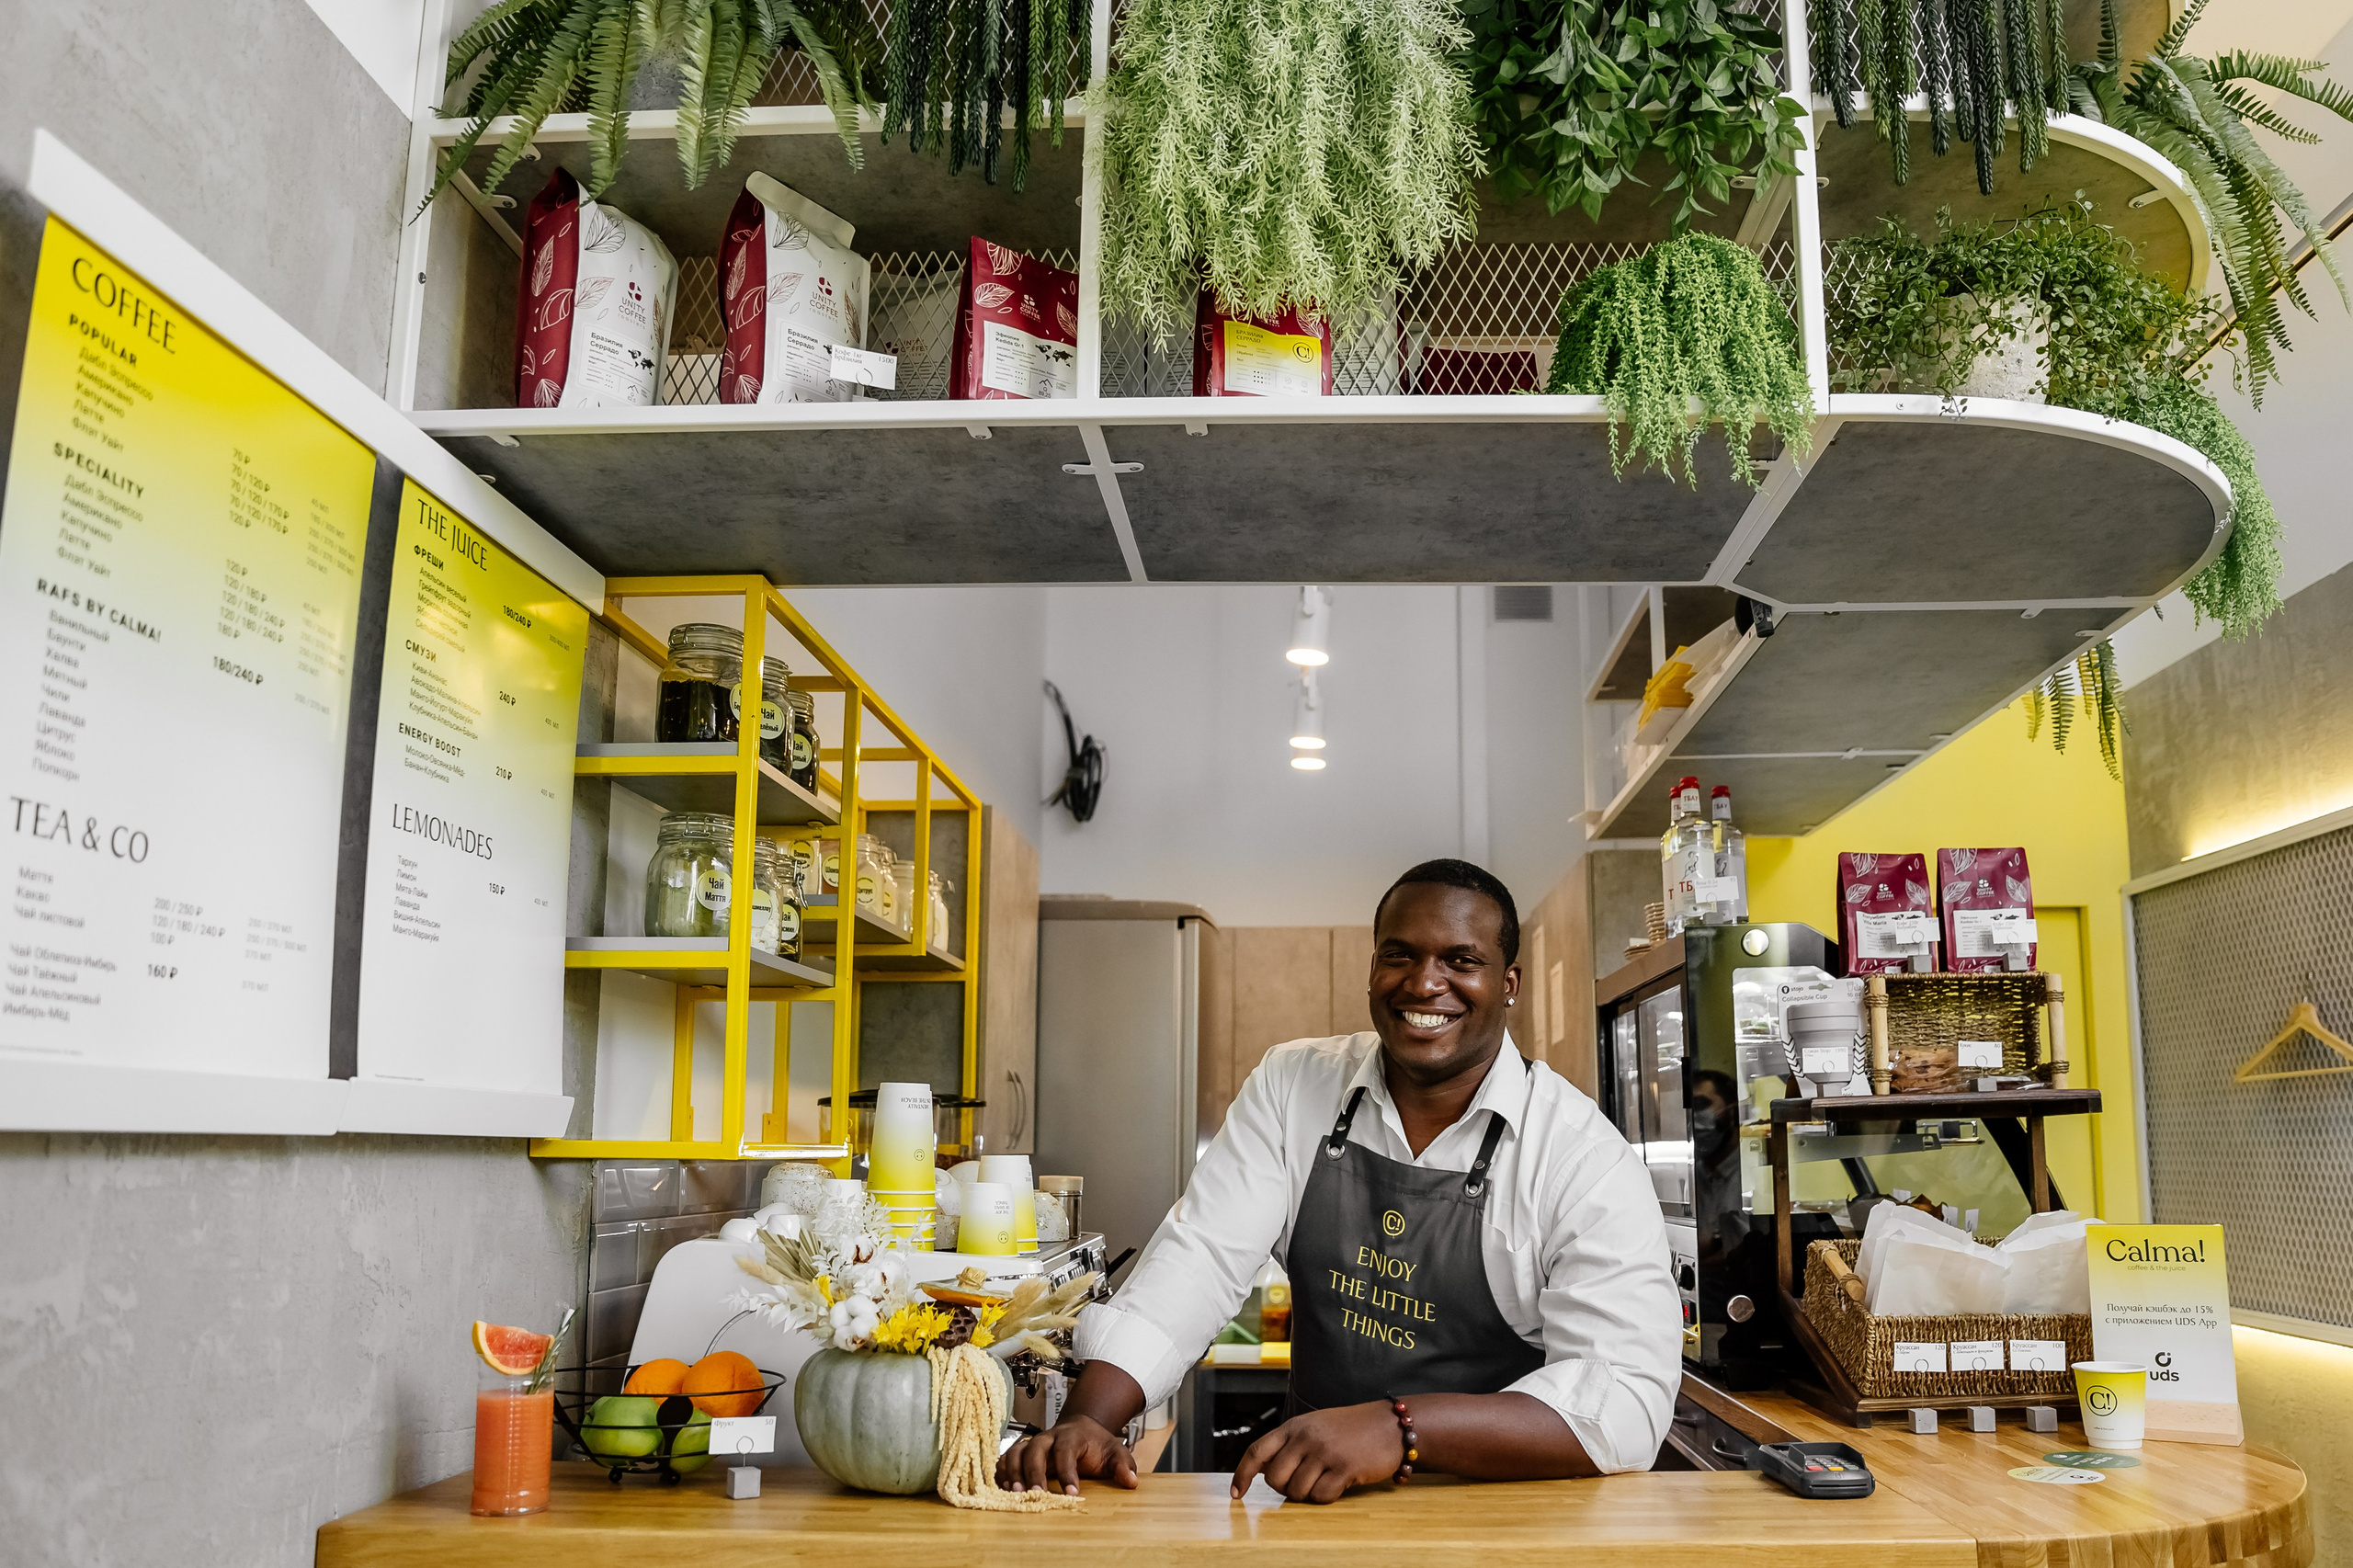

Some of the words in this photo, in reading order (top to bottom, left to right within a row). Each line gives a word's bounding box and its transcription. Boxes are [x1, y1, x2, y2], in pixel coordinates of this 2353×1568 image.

[73, 258, 176, 355] COFFEE
[621, 297, 645, 314] UNITY
[812, 291, 836, 308] UNITY
[1020, 302, 1039, 313] UNITY
[618, 305, 646, 324] COFFEE
[810, 299, 839, 318] COFFEE
[1020, 307, 1040, 320] COFFEE
[69, 313, 139, 367] POPULAR
[590, 332, 623, 348] Бразилия
[788, 328, 819, 345] Бразилия
[1236, 329, 1264, 339] БРАЗИЛИЯ
[1236, 335, 1261, 344] СЕРРАДО
[590, 341, 620, 356] Серрадо
[787, 335, 815, 351] Серрадо
[835, 347, 851, 358] Кофе
[878, 356, 894, 365] 1500
[77, 365, 135, 406] Американо
[75, 381, 126, 418] Капучино
[1039, 390, 1051, 399] 89.25
[54, 441, 144, 498] SPECIALITY
[61, 509, 113, 543] Капучино
[417, 498, 448, 541] THE
[451, 524, 488, 573] JUICE
[414, 544, 445, 572] ФРЕШИ
[37, 578, 81, 608] RAFS
[86, 597, 106, 617] BY
[108, 608, 162, 643] CALMA!
[503, 605, 528, 627] 180/240
[405, 639, 438, 664] СМУЗИ
[212, 655, 255, 684] 180/240
[499, 689, 511, 705] 240
[761, 709, 775, 720] Чай
[399, 722, 434, 747] ENERGY
[435, 737, 461, 759] BOOST
[495, 765, 507, 779] 210
[10, 796, 72, 845] TEA
[82, 817, 100, 851] &
[110, 825, 149, 864] CO
[392, 803, 494, 860] LEMONADES
[793, 849, 811, 859] Ваниль
[488, 882, 501, 895] 150
[709, 876, 724, 892] Чай
[705, 890, 726, 903] Маття
[147, 963, 167, 980] 160
[1782, 994, 1813, 1003] Collapsible
[2106, 1238, 2206, 1263] Calma!
[1357, 1245, 1417, 1282] ENJOY
[2168, 1265, 2187, 1273] juice
[1329, 1269, 1368, 1300] THE
[1371, 1286, 1436, 1322] LITTLE
[2107, 1303, 2143, 1314] Получай
[2145, 1303, 2177, 1313] кэшбэк
[2180, 1306, 2191, 1314] до
[2195, 1305, 2214, 1314] 15%
[1341, 1307, 1415, 1350] THINGS
[2112, 1317, 2173, 1327] приложением
[2175, 1317, 2196, 1326] UDS
[2199, 1318, 2217, 1329] App
[2150, 1369, 2180, 1381] uds
[2090, 1392, 2111, 1411] C!
[713, 1420, 734, 1429] Фрукт
